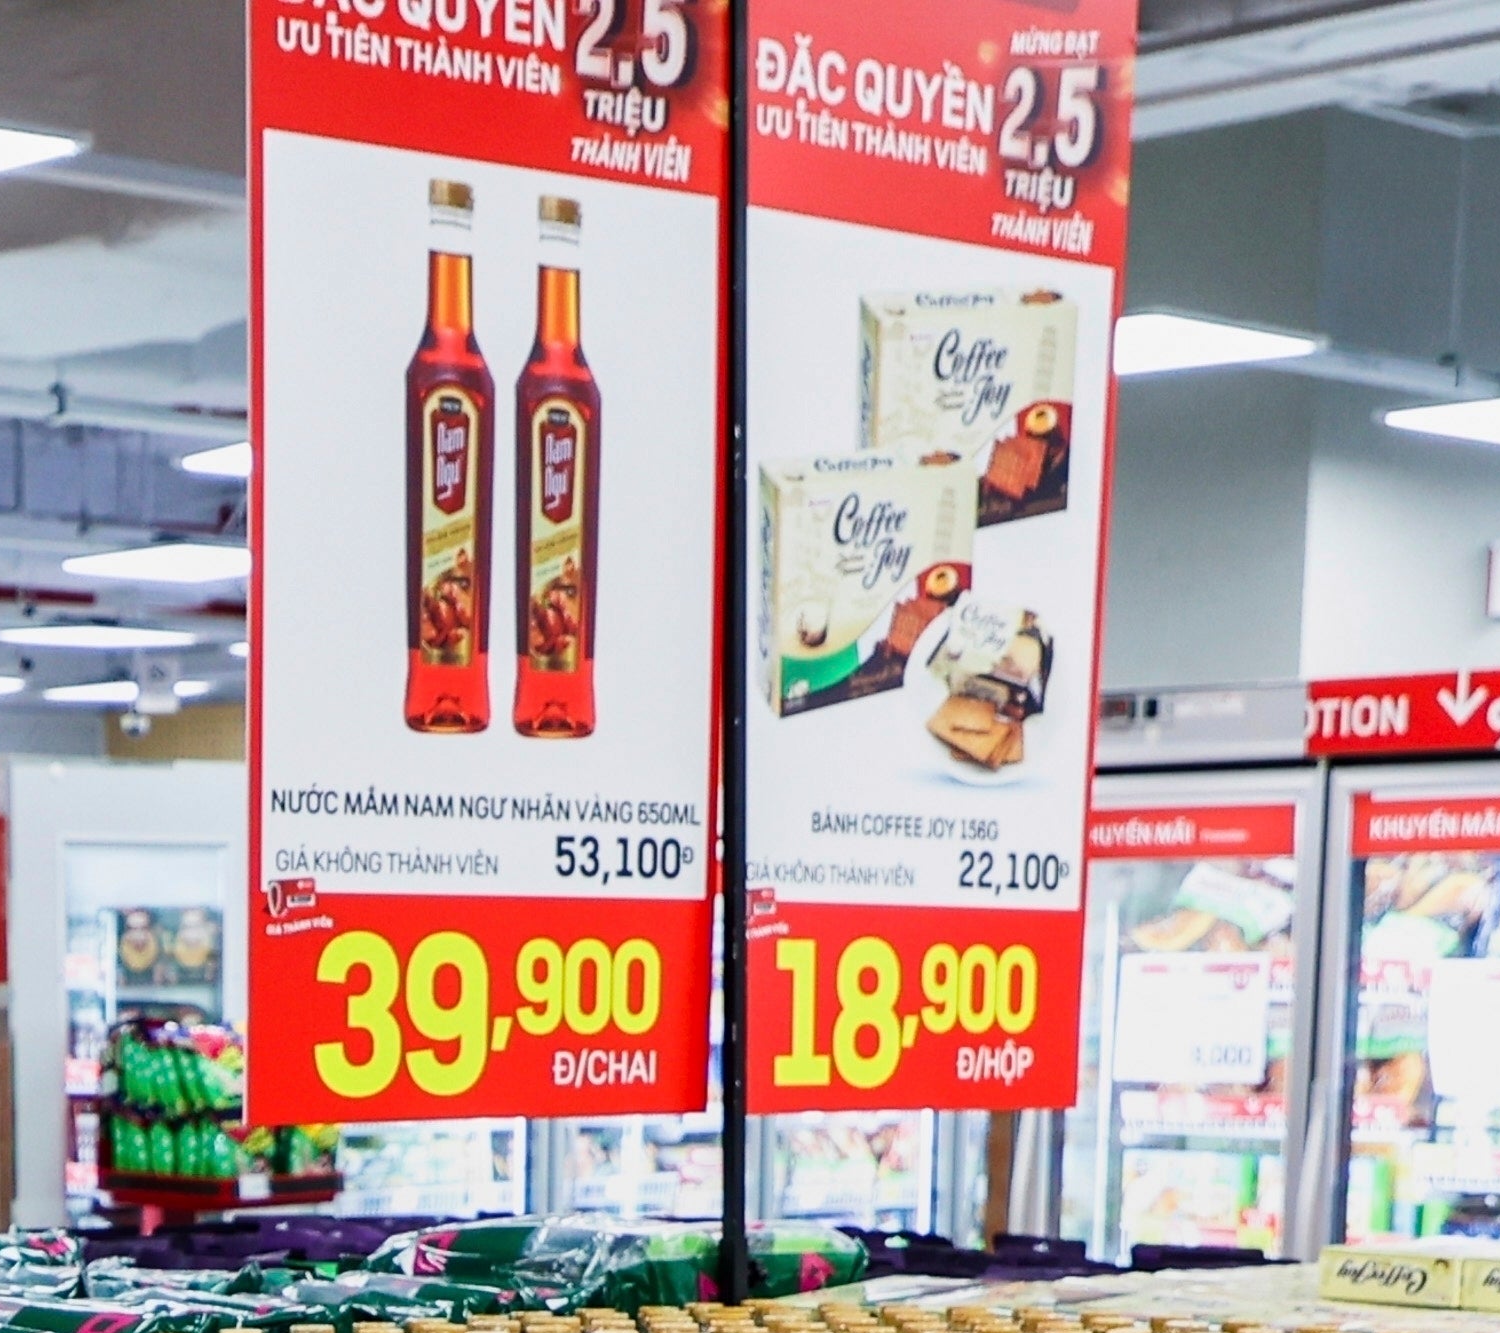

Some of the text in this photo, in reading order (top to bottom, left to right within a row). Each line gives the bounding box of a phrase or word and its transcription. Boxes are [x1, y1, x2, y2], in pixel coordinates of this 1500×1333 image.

[277, 17, 561, 95] ƯU TIÊN THÀNH VIÊN
[756, 32, 995, 135] ĐẶC QUYỀN
[584, 88, 666, 137] TRIỆU
[570, 135, 691, 183] THÀNH VIÊN
[756, 103, 988, 176] ƯU TIÊN THÀNH VIÊN
[1004, 166, 1074, 214] TRIỆU
[992, 211, 1094, 256] THÀNH VIÊN
[934, 328, 1009, 383] Coffee
[962, 376, 1013, 426] Joy
[437, 421, 465, 454] Nam
[834, 493, 909, 546] Coffee
[862, 539, 912, 590] Joy
[271, 783, 339, 816] NƯỚC
[404, 794, 455, 818] NAM
[459, 795, 509, 820] NGƯ
[511, 794, 570, 822] NHÃN
[575, 791, 633, 824] VÀNG
[637, 801, 701, 826] 650ML
[811, 805, 857, 835] BÁNH
[861, 815, 923, 838] COFFEE
[926, 818, 956, 838] JOY
[275, 844, 499, 876] GIÁ KHÔNG THÀNH VIÊN
[746, 856, 914, 887] GIÁ KHÔNG THÀNH VIÊN
[312, 929, 662, 1101] 39,900
[773, 935, 1037, 1090] 18,900
[551, 1046, 658, 1089] Đ/CHAI
[957, 1042, 1034, 1088] Đ/HỘP
